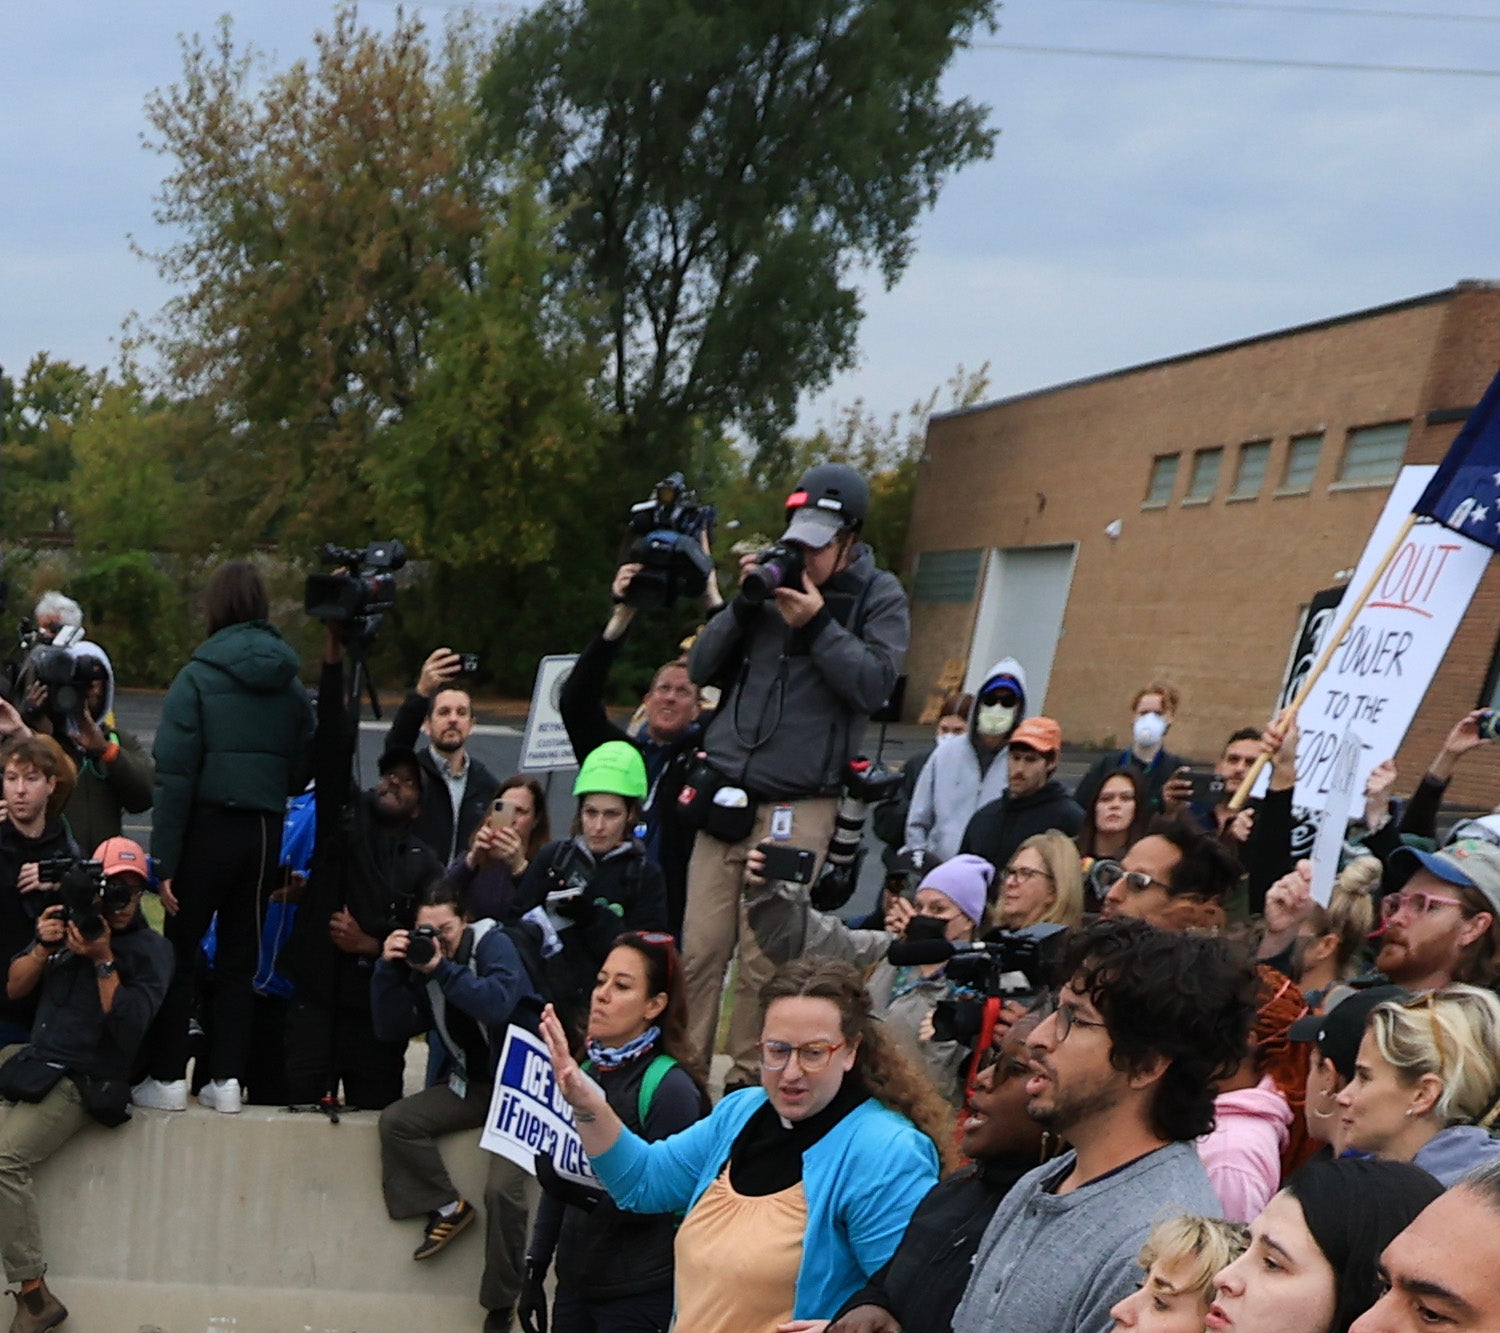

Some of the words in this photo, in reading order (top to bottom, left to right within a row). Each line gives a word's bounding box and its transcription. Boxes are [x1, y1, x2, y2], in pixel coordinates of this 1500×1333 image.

[1381, 542, 1462, 604] OUT
[1325, 690, 1350, 719] TO
[1353, 695, 1389, 723] THE
[521, 1050, 552, 1105] ICE
